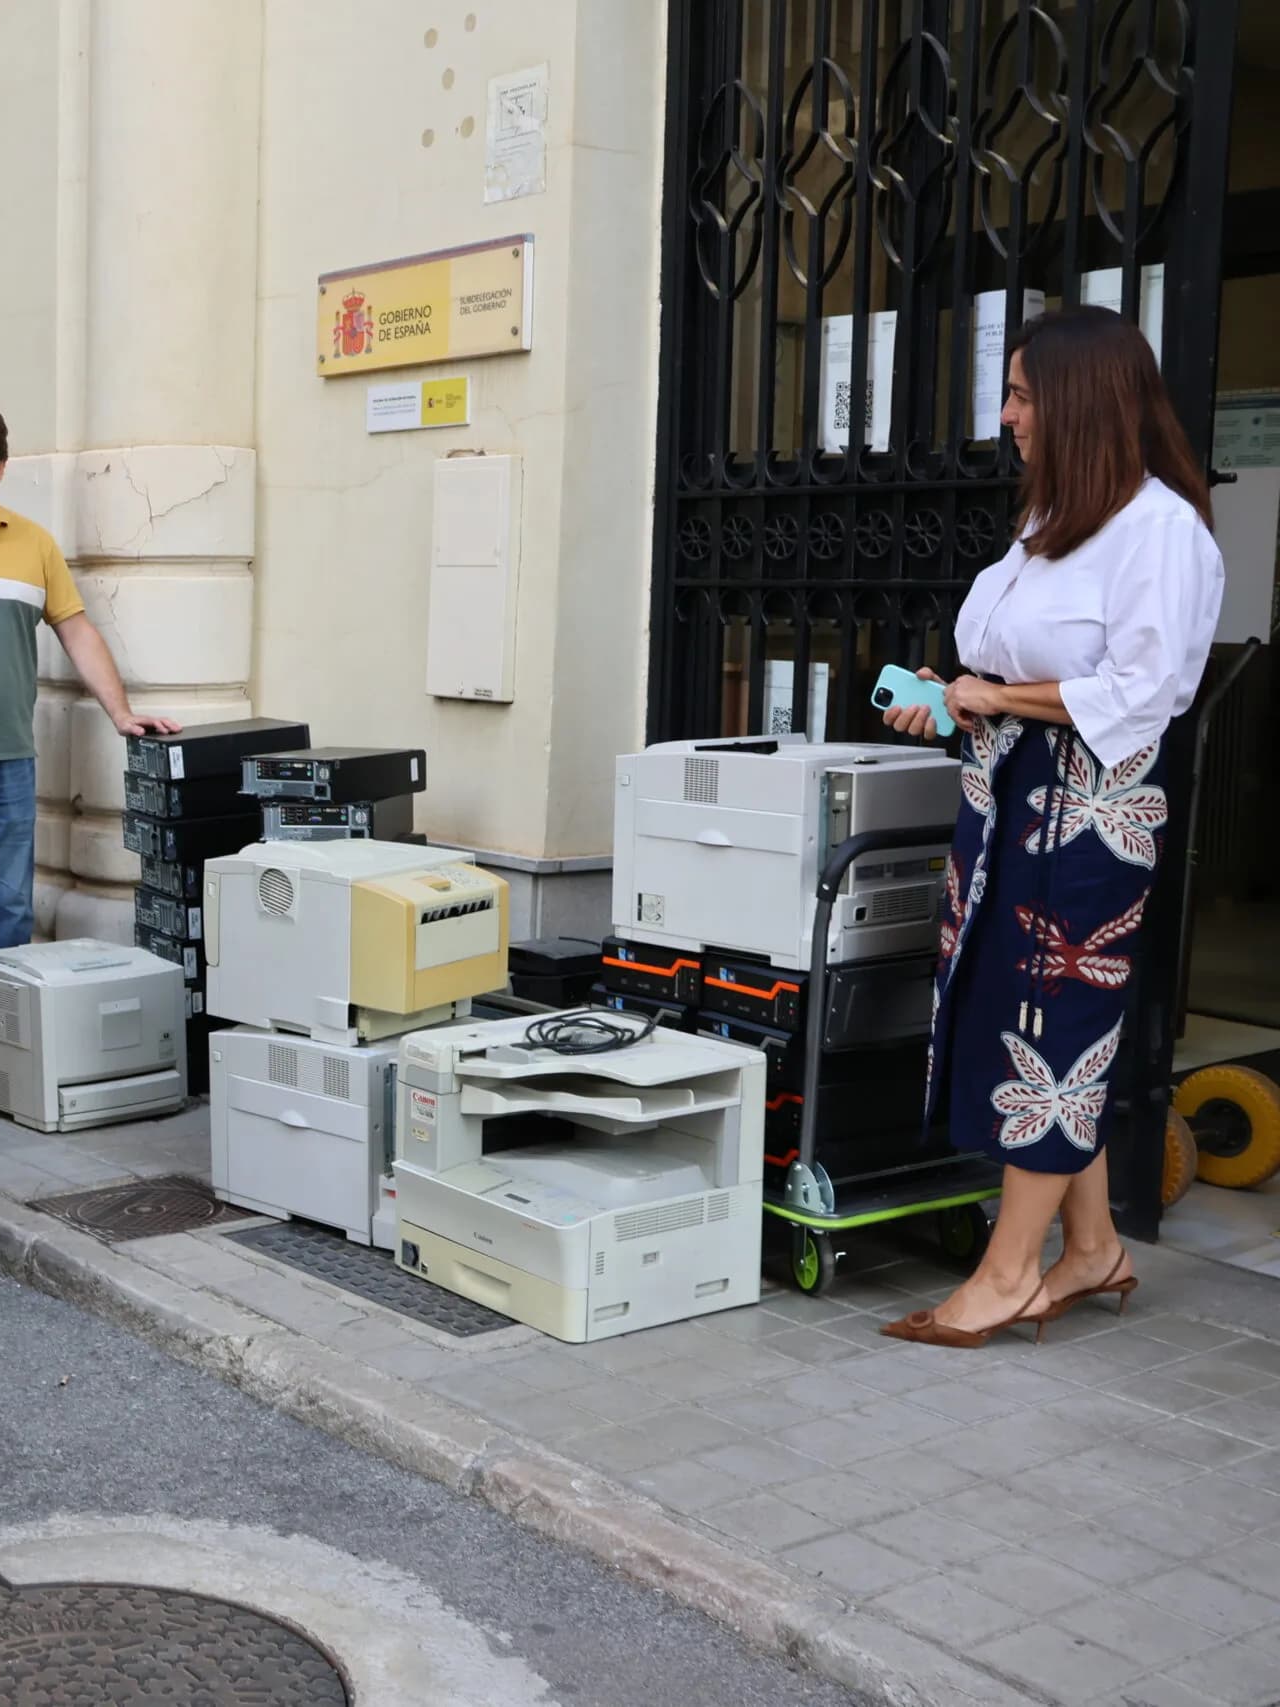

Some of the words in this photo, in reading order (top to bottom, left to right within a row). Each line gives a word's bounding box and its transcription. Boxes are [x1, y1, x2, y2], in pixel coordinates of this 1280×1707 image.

[379, 305, 432, 325] GOBIERNO
[459, 305, 471, 316] DEL
[472, 299, 507, 313] GOBIERNO
[379, 327, 391, 341] DE
[394, 320, 431, 339] ESPAÑA
